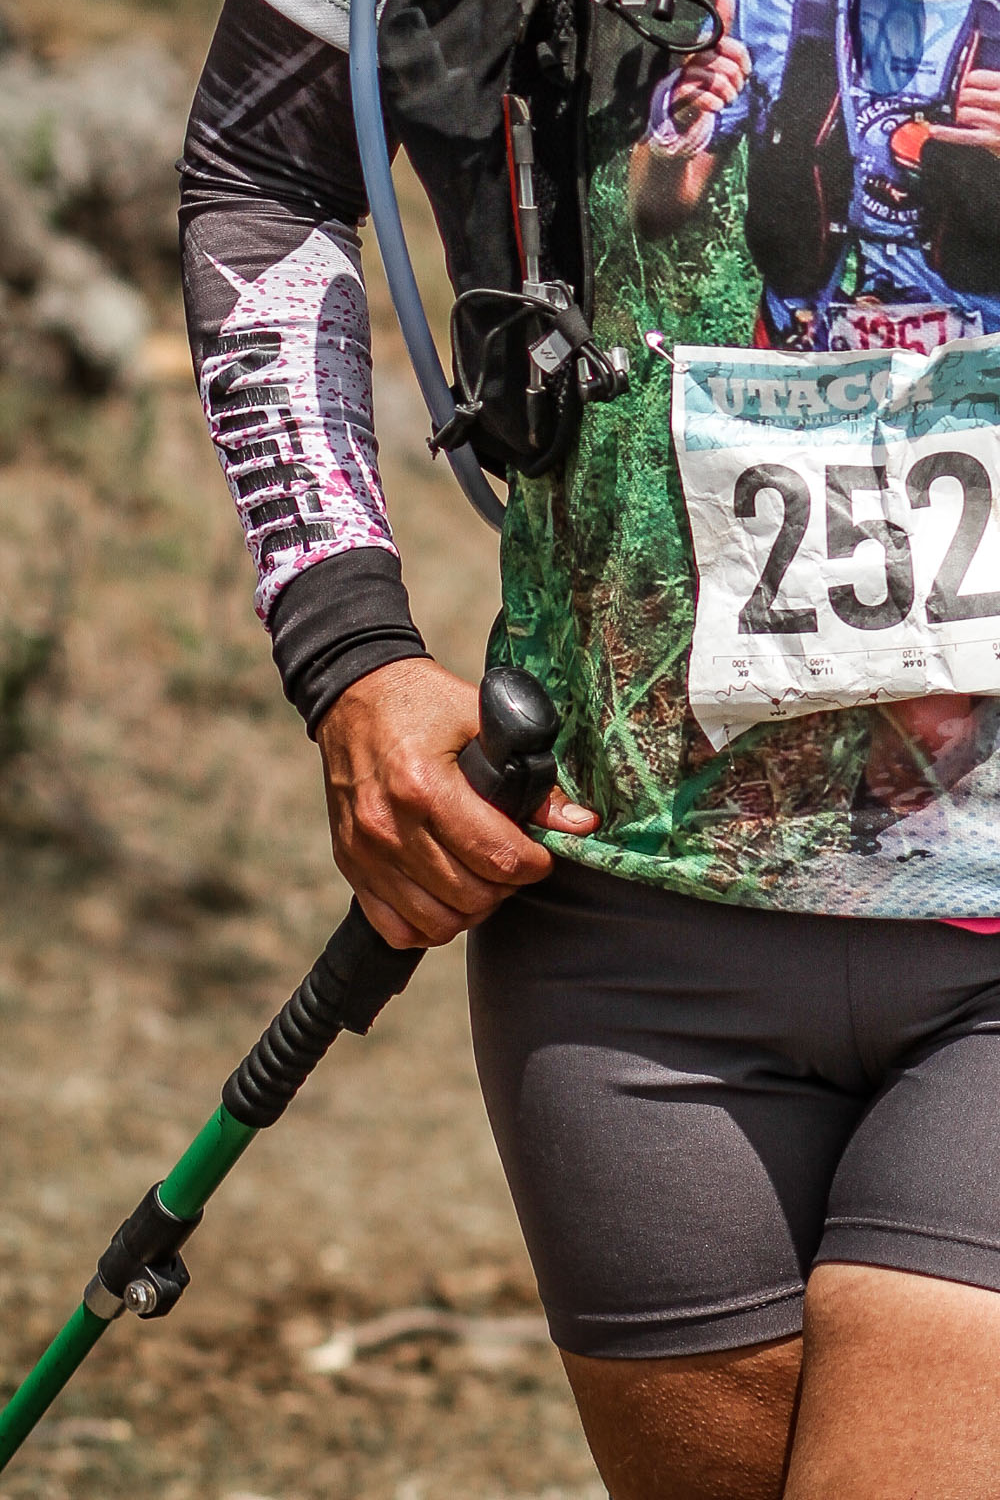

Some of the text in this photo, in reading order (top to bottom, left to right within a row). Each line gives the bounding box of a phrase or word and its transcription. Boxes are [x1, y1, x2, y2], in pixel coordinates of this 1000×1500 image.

[757, 418, 793, 429] TRAIL
[797, 413, 867, 428] AMANECER
[902, 649, 923, 659] +120
[731, 658, 754, 669] +300
[902, 659, 927, 669] 10.6K
[737, 668, 749, 678] 8K
